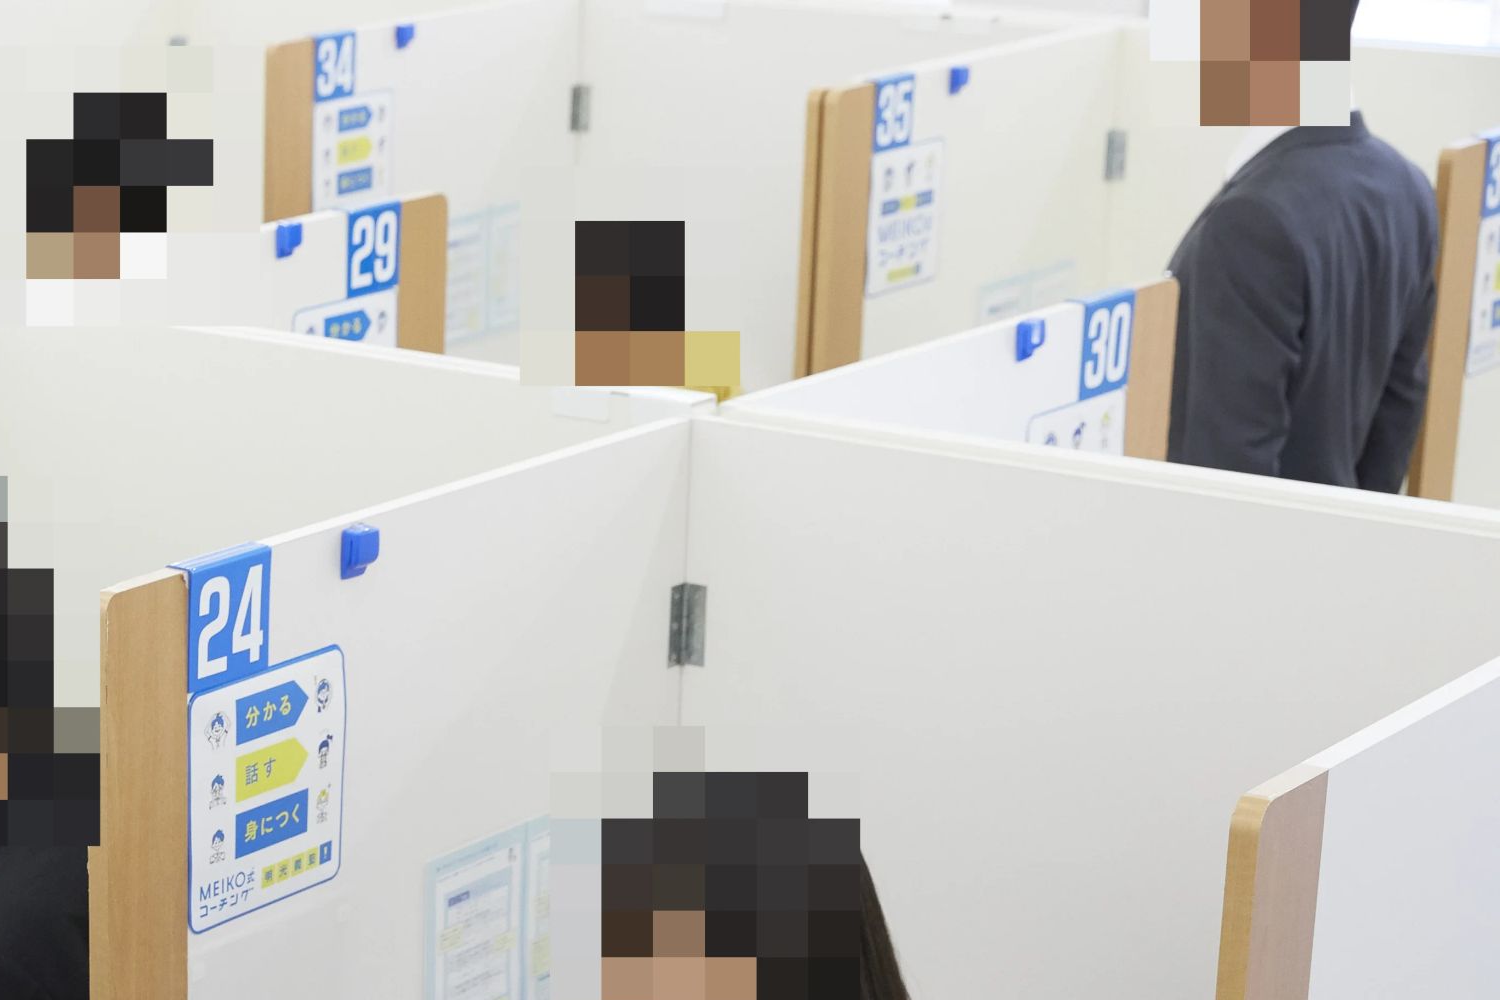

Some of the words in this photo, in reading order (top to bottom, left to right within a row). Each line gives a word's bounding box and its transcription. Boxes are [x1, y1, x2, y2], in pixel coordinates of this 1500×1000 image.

[316, 35, 354, 97] 34
[876, 79, 912, 147] 35
[1486, 141, 1500, 210] 3
[350, 210, 398, 290] 29
[1084, 302, 1132, 390] 30
[196, 563, 264, 681] 24
[245, 694, 292, 729] 分かる
[244, 756, 277, 786] 話す
[244, 802, 301, 843] 身につく
[199, 867, 255, 902] MEIKO式
[199, 887, 255, 919] コーチング
